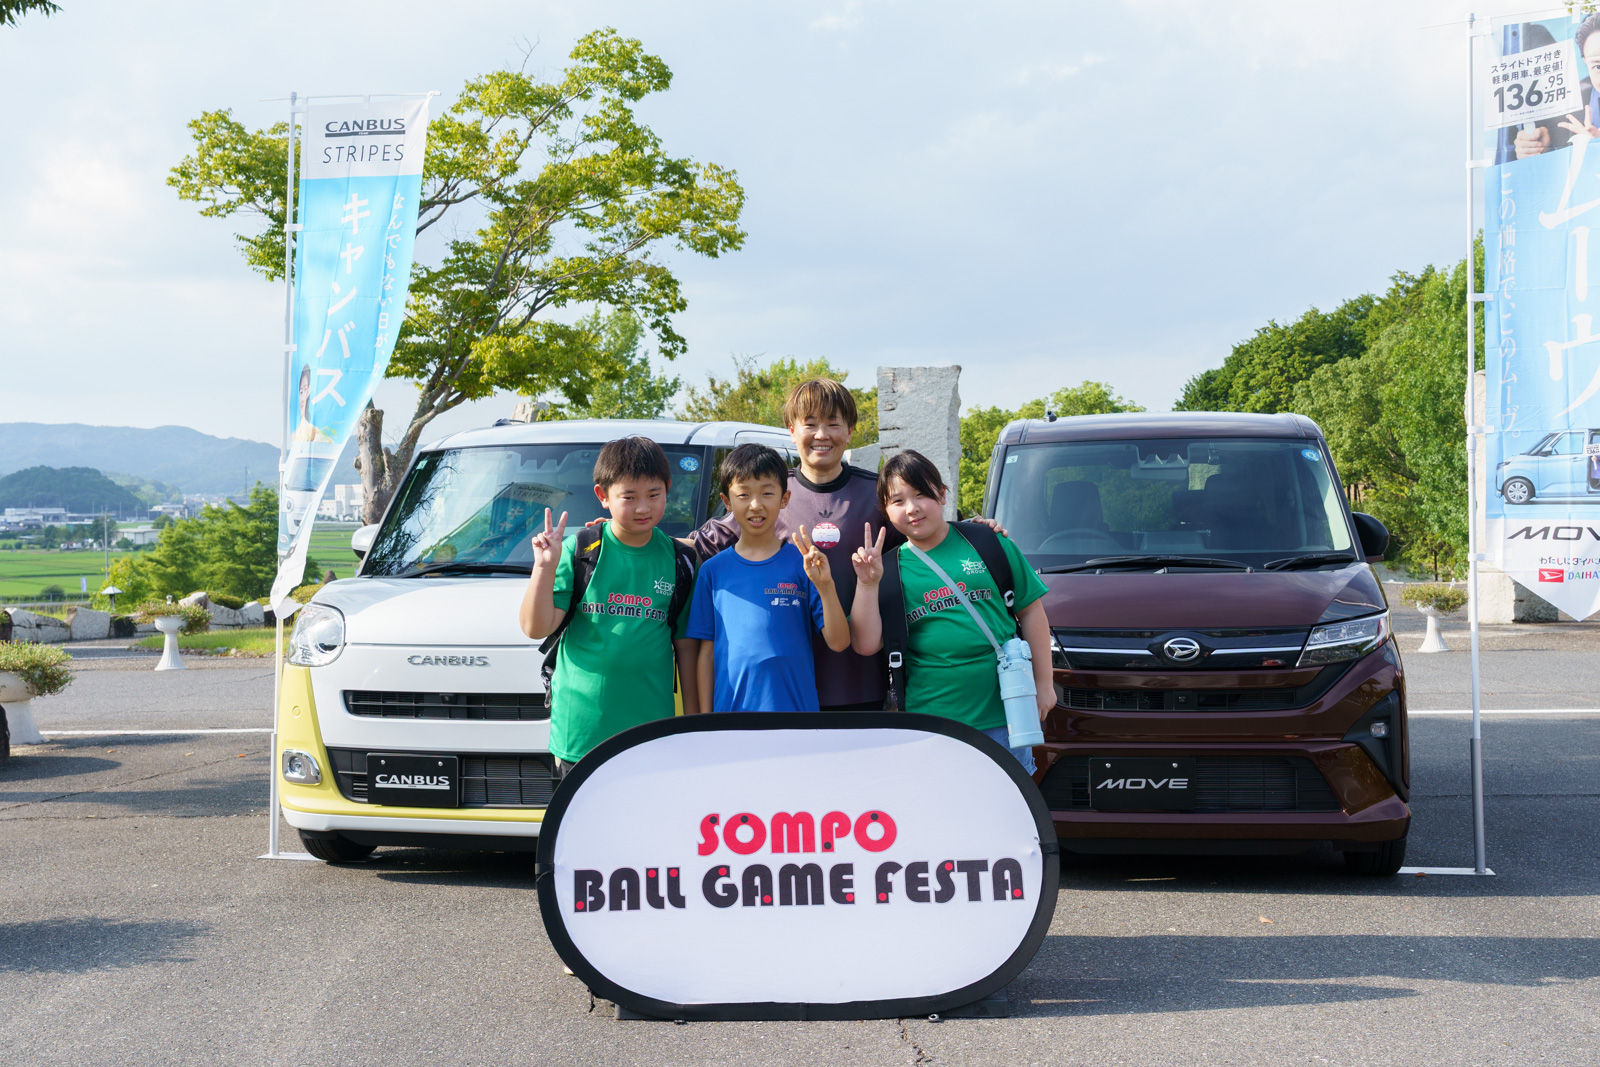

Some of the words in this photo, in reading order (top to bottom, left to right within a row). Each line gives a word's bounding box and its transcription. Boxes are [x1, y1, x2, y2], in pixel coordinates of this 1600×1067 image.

[1491, 49, 1562, 74] スライドドア付き
[325, 118, 405, 132] CANBUS
[322, 143, 404, 164] STRIPES
[311, 193, 370, 407] キャンバス
[1568, 571, 1600, 580] DAIHA
[608, 592, 652, 607] SOMPO
[906, 606, 928, 623] BALL
[928, 595, 962, 613] GAME
[964, 588, 991, 601] ESTA
[582, 602, 605, 614] BALL
[608, 605, 642, 618] GAME
[407, 655, 490, 666] CANBUS
[375, 774, 450, 785] CANBUS
[1096, 778, 1189, 789] MOVE
[697, 809, 898, 857] SOMPO
[573, 866, 687, 914] BALL
[701, 862, 856, 909] GAME
[874, 857, 1025, 904] FESTA
